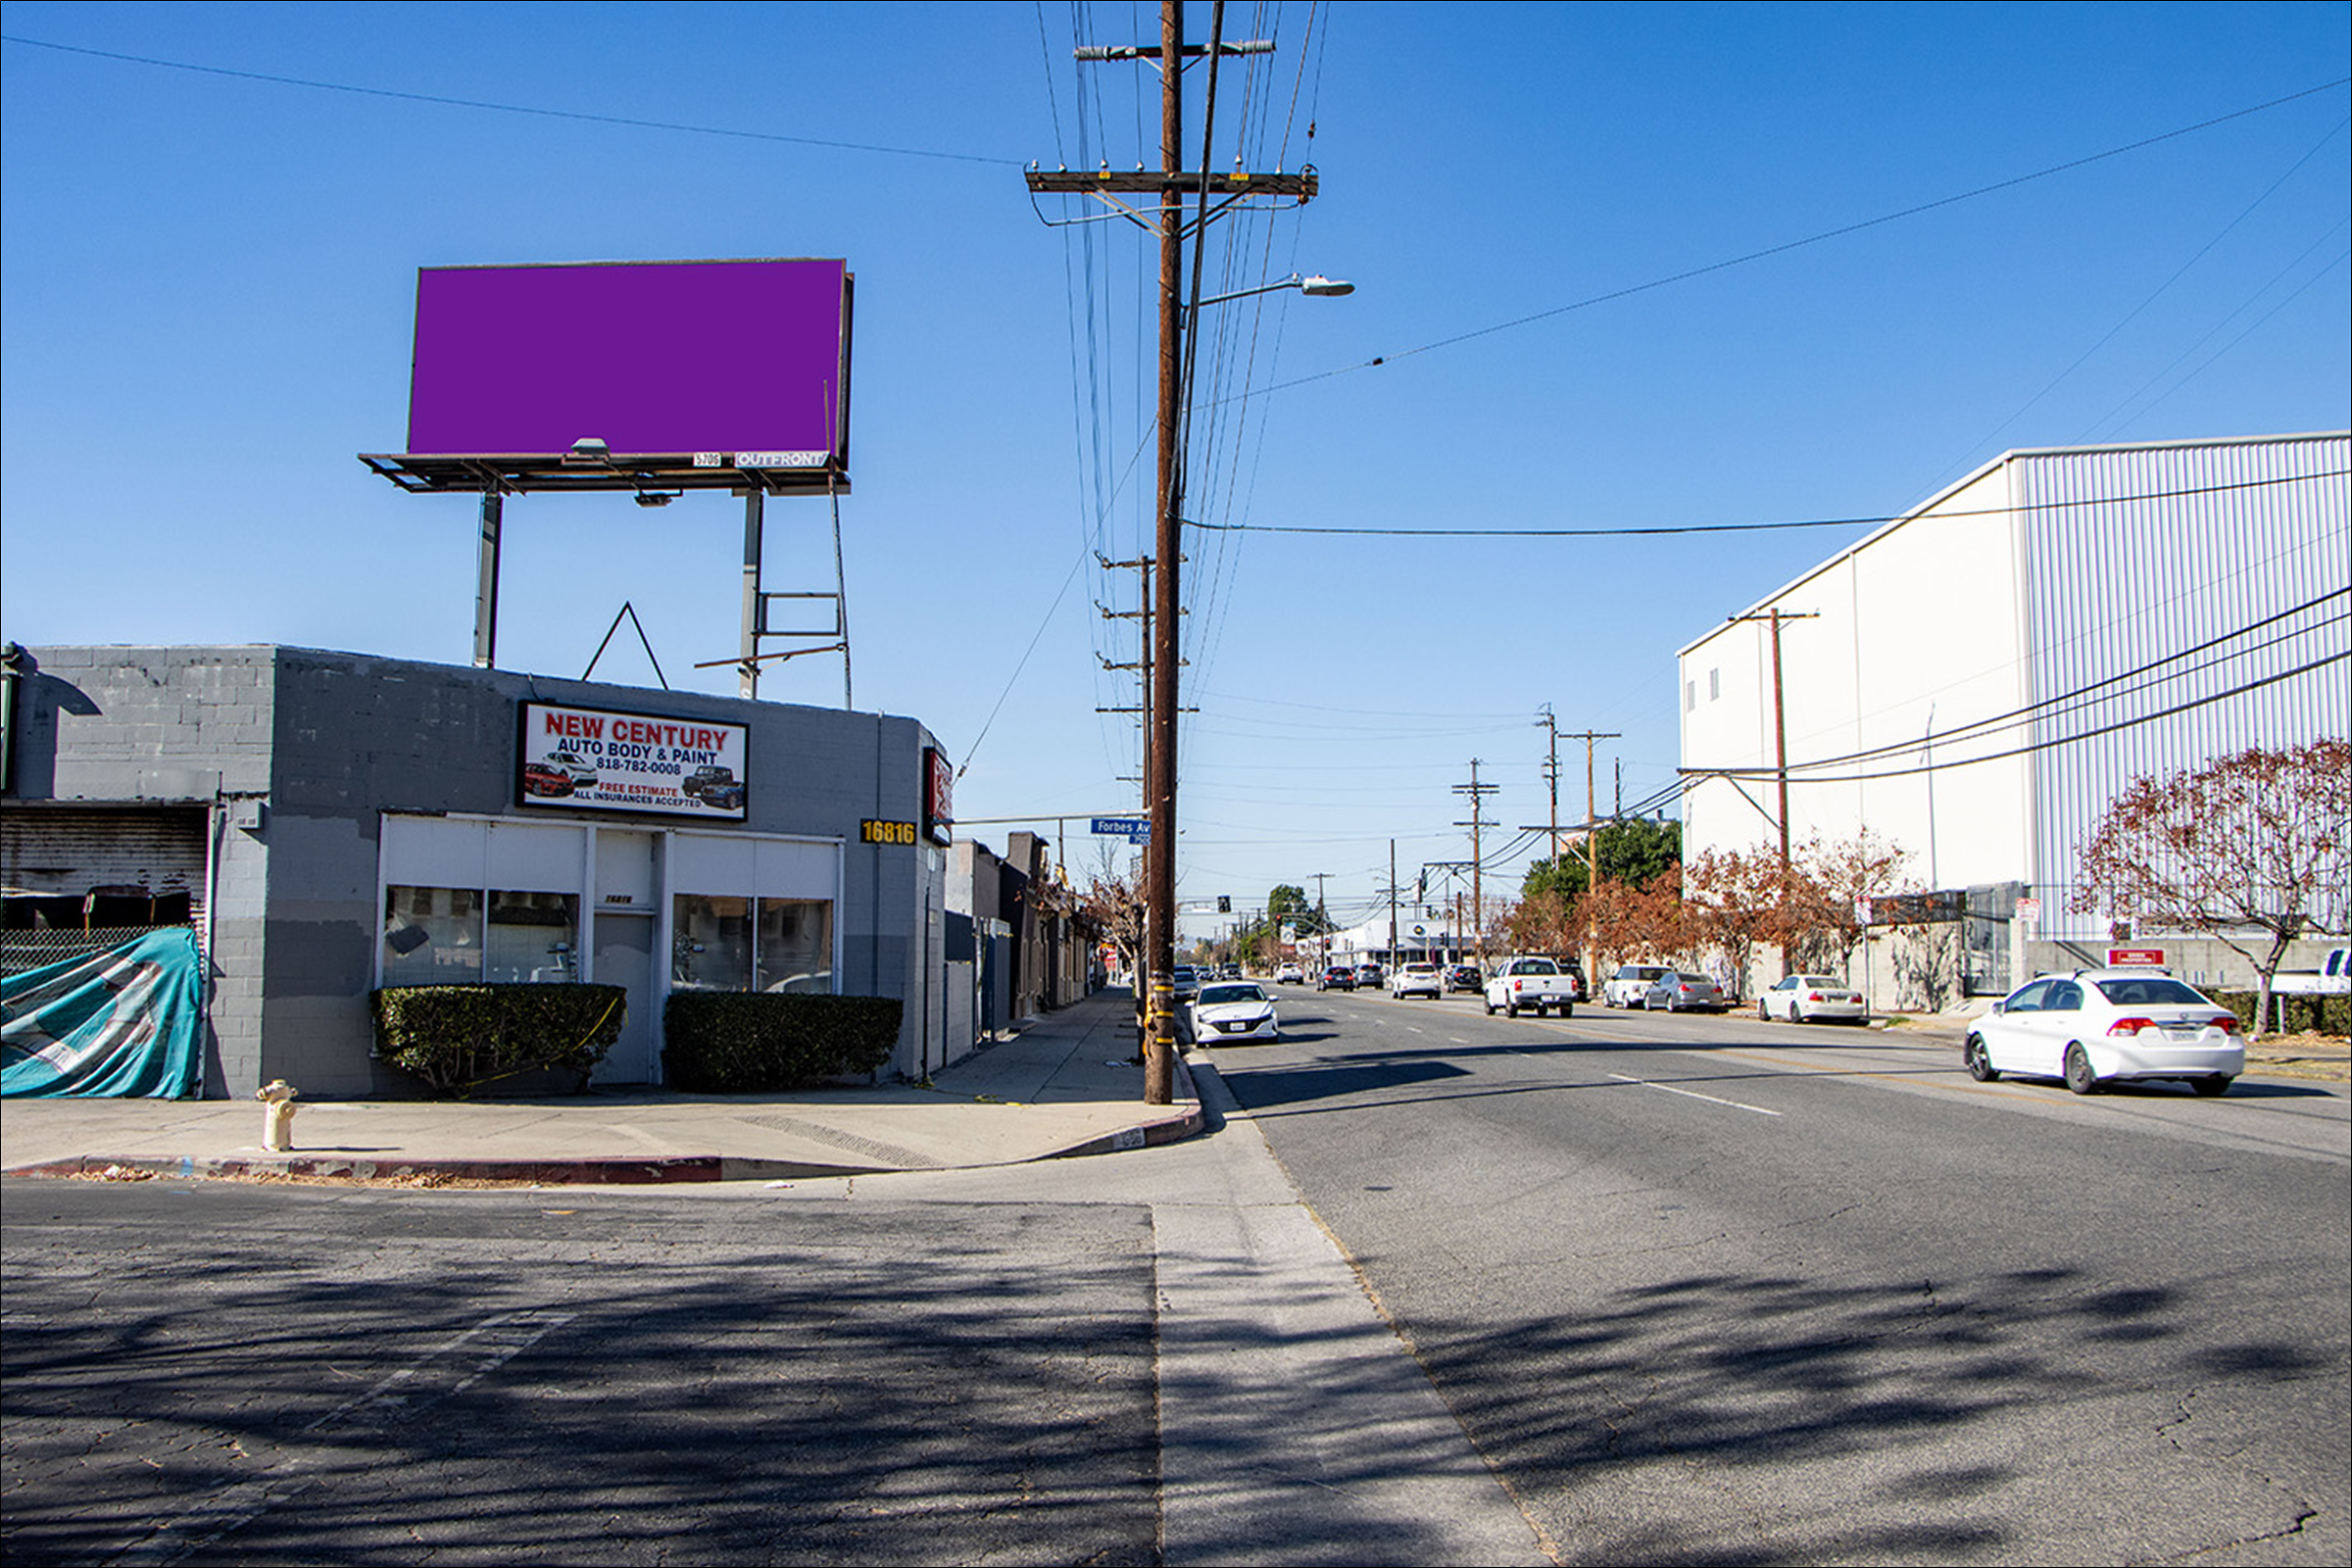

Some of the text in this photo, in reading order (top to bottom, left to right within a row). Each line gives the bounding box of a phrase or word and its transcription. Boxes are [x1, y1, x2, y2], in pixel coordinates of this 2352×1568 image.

[739, 453, 823, 466] OUTFRONT
[546, 713, 728, 751] NEW CENTURY
[558, 738, 717, 764] AUTO BODY & PAINT
[596, 757, 681, 775] 818-782-0008
[599, 782, 678, 797] FREE ESTIMATE
[573, 790, 702, 808] ALL INSURANCES ACCEPTED
[863, 820, 914, 844] 16816
[1098, 820, 1133, 832] Forbes
